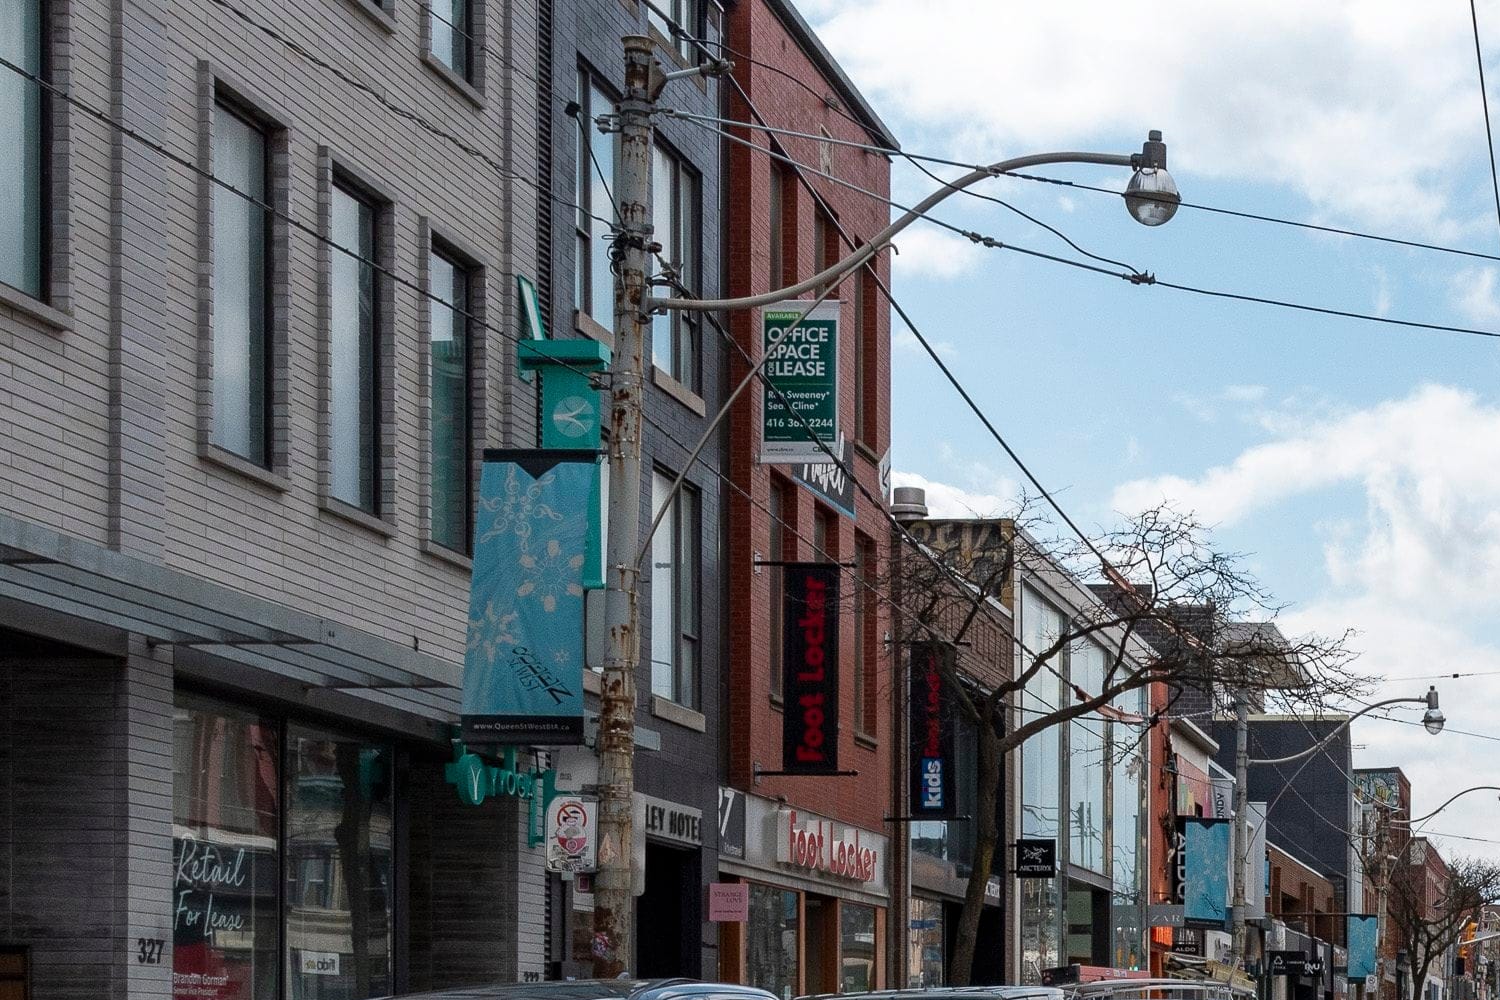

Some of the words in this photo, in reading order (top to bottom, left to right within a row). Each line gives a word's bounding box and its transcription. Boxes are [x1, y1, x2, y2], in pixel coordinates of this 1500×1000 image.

[767, 327, 829, 343] OFFICE
[767, 344, 820, 360] SPACE
[775, 361, 826, 377] LEASE
[768, 391, 785, 400] Rb
[766, 418, 785, 428] 416
[809, 418, 834, 428] 2244
[796, 575, 827, 684] Locker
[795, 692, 826, 763] Foot
[923, 759, 943, 809] kids
[175, 832, 246, 888] Retail
[788, 810, 825, 872] Foot
[829, 821, 878, 883] Locker
[174, 888, 201, 931] For
[203, 893, 245, 938] Lease
[137, 938, 165, 965] 327
